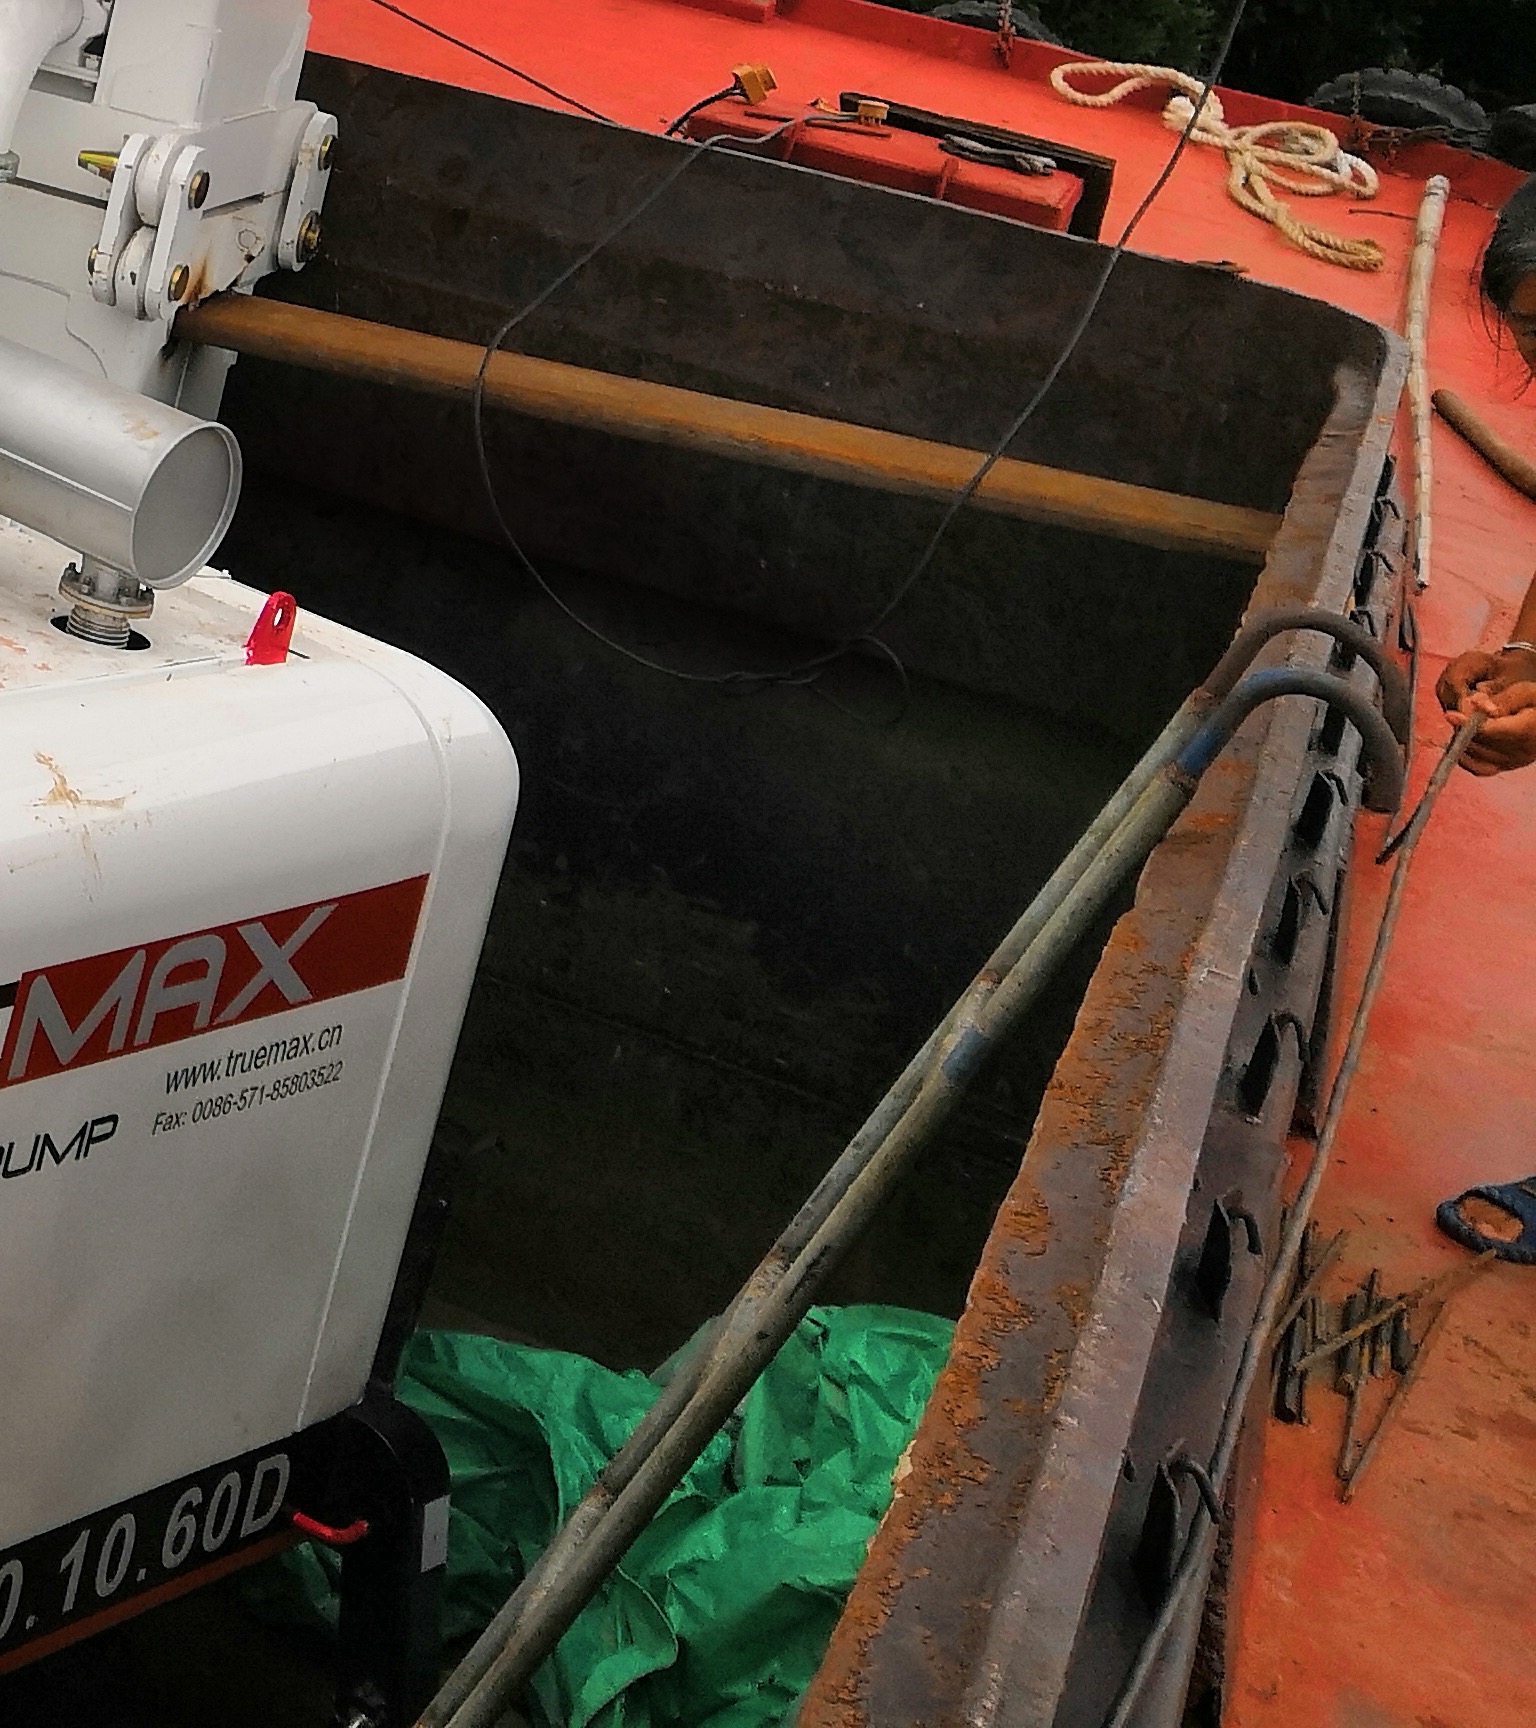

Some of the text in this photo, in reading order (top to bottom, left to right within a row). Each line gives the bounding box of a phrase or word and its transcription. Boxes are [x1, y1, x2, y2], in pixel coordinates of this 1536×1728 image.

[165, 1023, 344, 1095] www.truemax.cn
[151, 1060, 344, 1136] Fax: 0086-571-85803522
